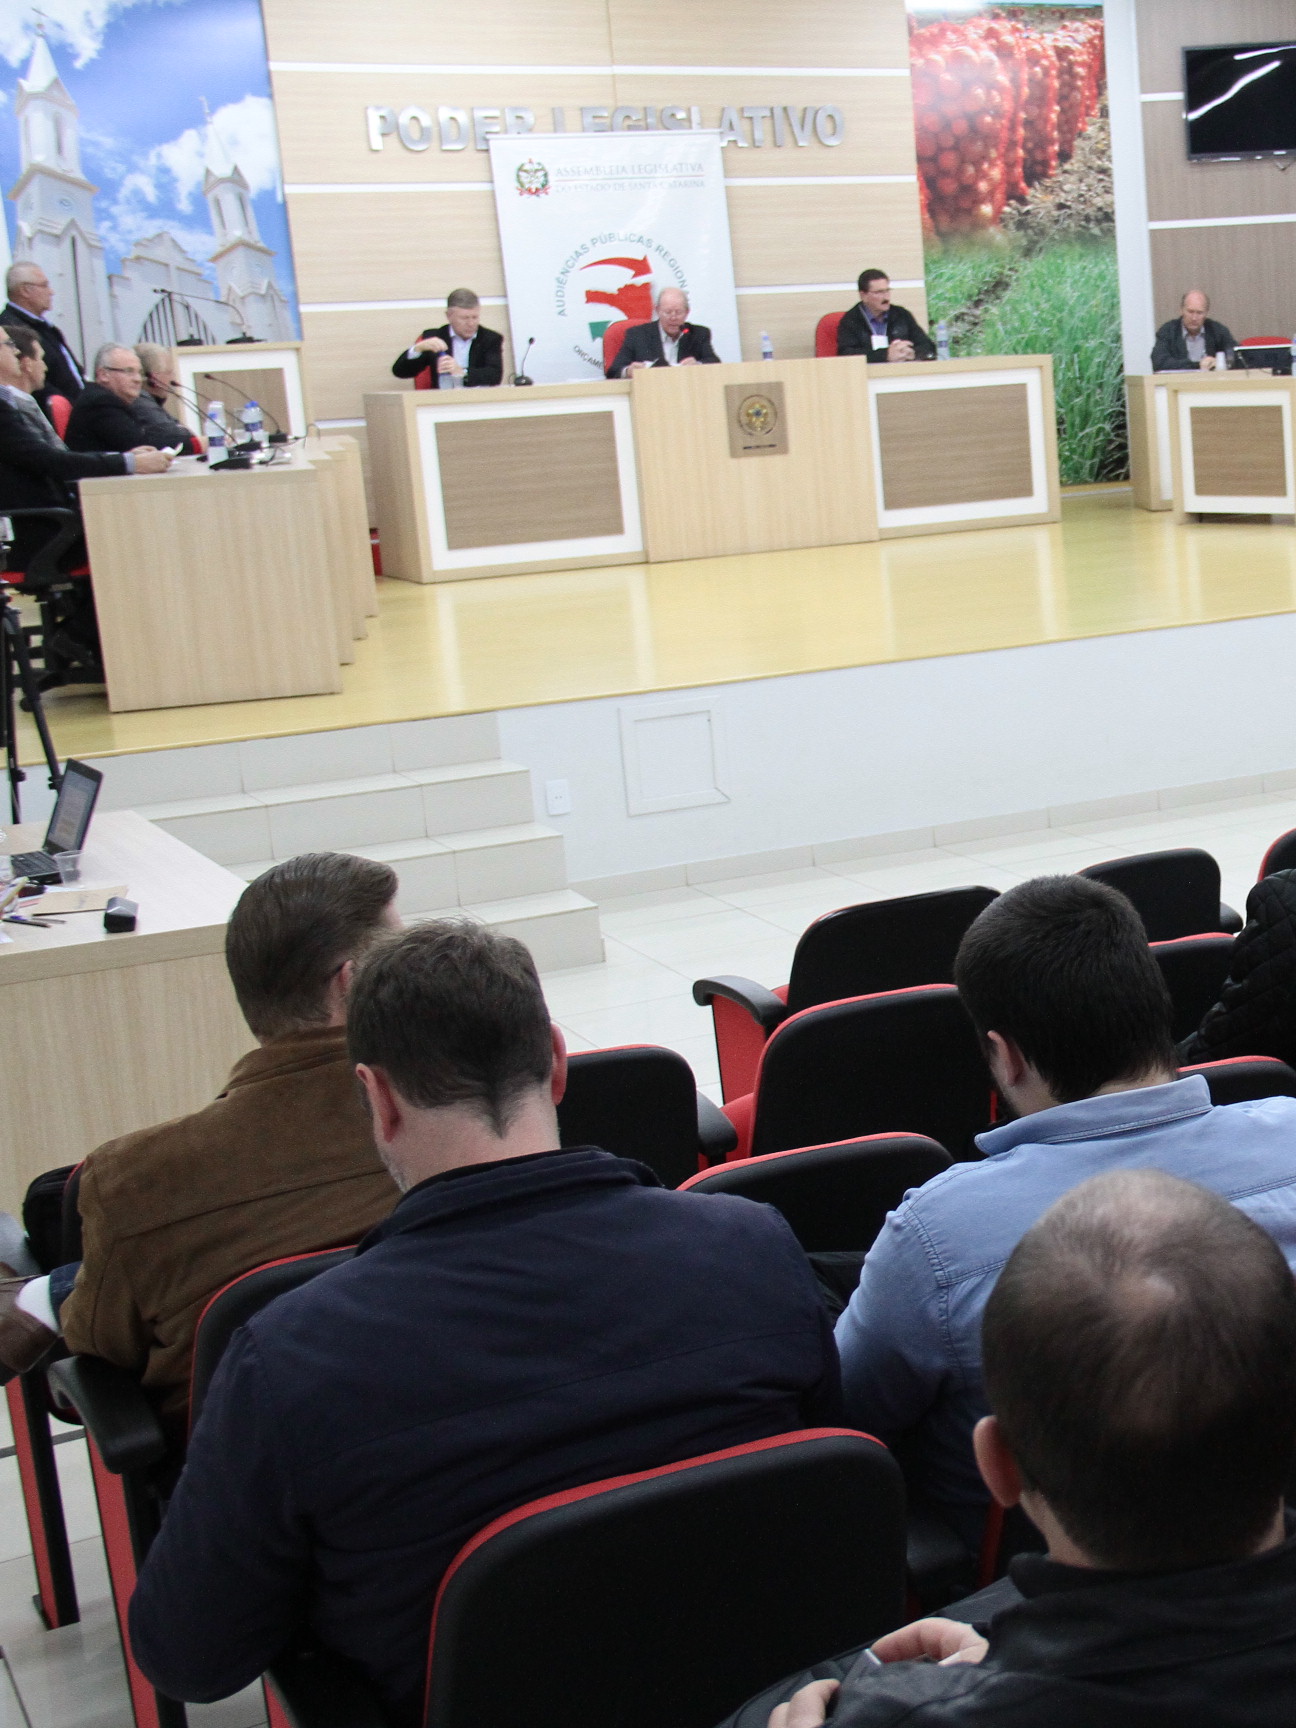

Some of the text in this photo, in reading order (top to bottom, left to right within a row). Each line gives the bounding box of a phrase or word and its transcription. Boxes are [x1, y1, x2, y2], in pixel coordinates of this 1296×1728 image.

[366, 104, 845, 151] PODER LEGISLATIVO
[632, 163, 704, 175] LEGISLATIVA
[555, 244, 590, 317] AUDIÊNCIAS
[591, 232, 653, 248] PÚBLICAS
